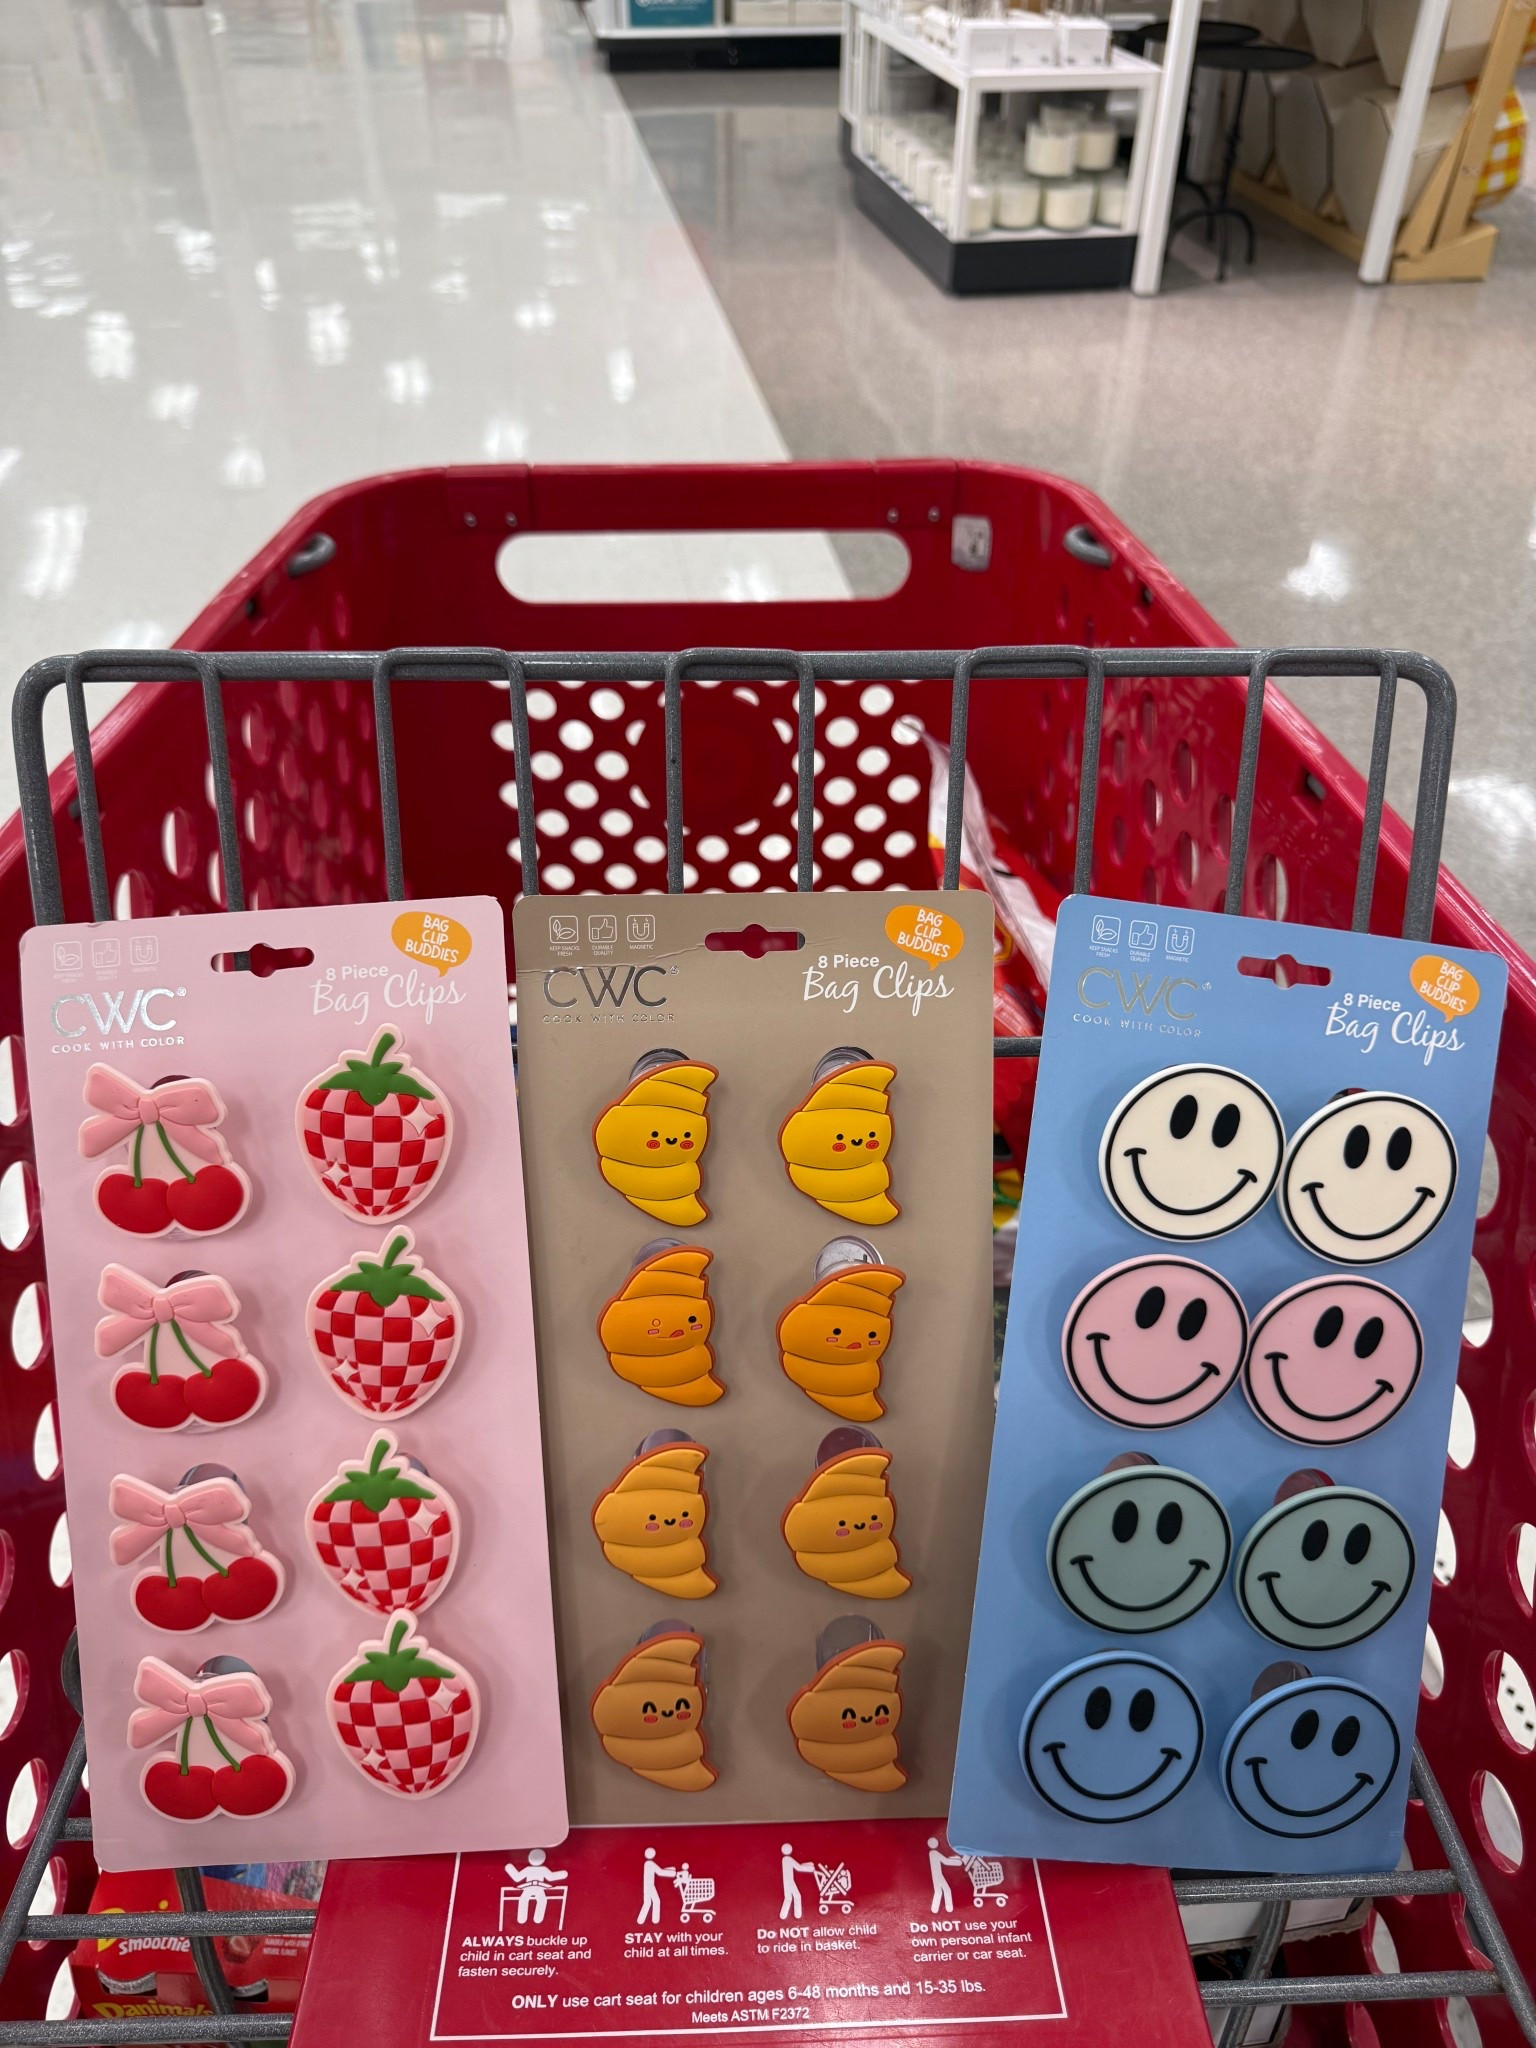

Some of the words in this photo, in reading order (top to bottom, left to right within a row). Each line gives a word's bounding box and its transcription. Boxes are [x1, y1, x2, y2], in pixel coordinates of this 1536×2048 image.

[423, 915, 449, 932] BAG
[917, 909, 943, 927] BAG
[421, 930, 449, 946] CLIP
[914, 924, 942, 939] CLIP
[404, 939, 459, 963] BUDDIES
[897, 932, 950, 958] BUDDIES
[817, 955, 828, 969] 8
[833, 954, 880, 968] Piece
[326, 967, 336, 981] 8
[342, 965, 389, 980] Piece
[1440, 961, 1464, 981] BAG
[802, 966, 860, 1014] Bag
[873, 961, 955, 1016] Clips
[1436, 976, 1460, 993] CLIP
[310, 979, 369, 1025] Bag
[383, 969, 466, 1025] Clips
[1343, 993, 1353, 1006] 8
[1357, 994, 1401, 1012] Piece
[1419, 980, 1467, 1012] BUDDIES
[543, 1014, 582, 1024] COOK
[591, 1014, 625, 1023] WITH
[632, 1013, 675, 1023] COLOR
[1073, 1013, 1112, 1026] COOK
[1120, 1019, 1152, 1031] WITH
[1159, 1025, 1201, 1037] COLOR
[1325, 1002, 1379, 1053] Bag
[1391, 1010, 1465, 1066] Clips
[51, 1042, 92, 1054] COOK
[100, 1039, 134, 1051] WITH
[141, 1036, 185, 1048] COLOR
[757, 1928, 777, 1940] Do
[780, 1926, 809, 1939] NOT
[812, 1926, 845, 1938] allow
[848, 1924, 877, 1936] child
[909, 1922, 929, 1934] Do
[932, 1920, 961, 1933] NOT
[965, 1921, 987, 1931] use
[990, 1919, 1017, 1932] your
[462, 1936, 524, 1947] ALWAYS
[527, 1935, 568, 1947] buckle
[571, 1937, 588, 1949] up
[624, 1932, 663, 1944] STAY
[666, 1932, 692, 1943] with
[695, 1932, 723, 1945] your
[757, 1943, 770, 1954] to
[773, 1941, 797, 1953] ride
[801, 1941, 812, 1952] in
[815, 1939, 861, 1951] basket.
[911, 1937, 937, 1948] own
[941, 1933, 994, 1948] personal
[997, 1931, 1032, 1944] infant
[460, 1950, 490, 1962] child
[494, 1950, 505, 1961] in
[508, 1950, 533, 1961] cart
[537, 1950, 564, 1961] seat
[567, 1949, 592, 1960] and
[624, 1947, 654, 1958] child
[657, 1947, 670, 1958] at
[673, 1946, 688, 1957] all
[690, 1945, 729, 1957] times.
[913, 1950, 953, 1963] carrier
[957, 1950, 969, 1960] or
[973, 1949, 992, 1960] car
[996, 1947, 1027, 1959] seat.
[458, 1965, 498, 1977] fasten
[501, 1964, 559, 1978] securely.
[511, 1994, 558, 2009] ONLY
[562, 1996, 589, 2008] use
[593, 1993, 622, 2007] cart
[626, 1992, 658, 2006] seat
[661, 1991, 681, 2005] for
[685, 1989, 744, 2004] children
[748, 1989, 784, 2004] ages
[788, 1985, 821, 2000] 6-48
[825, 1983, 879, 1998] months
[883, 1981, 910, 1996] and
[916, 1979, 957, 1994] 15-35
[961, 1979, 986, 1993] lbs.
[691, 2011, 728, 2024] Meets
[731, 2009, 768, 2022] ASTM
[772, 2007, 810, 2020] F2372
